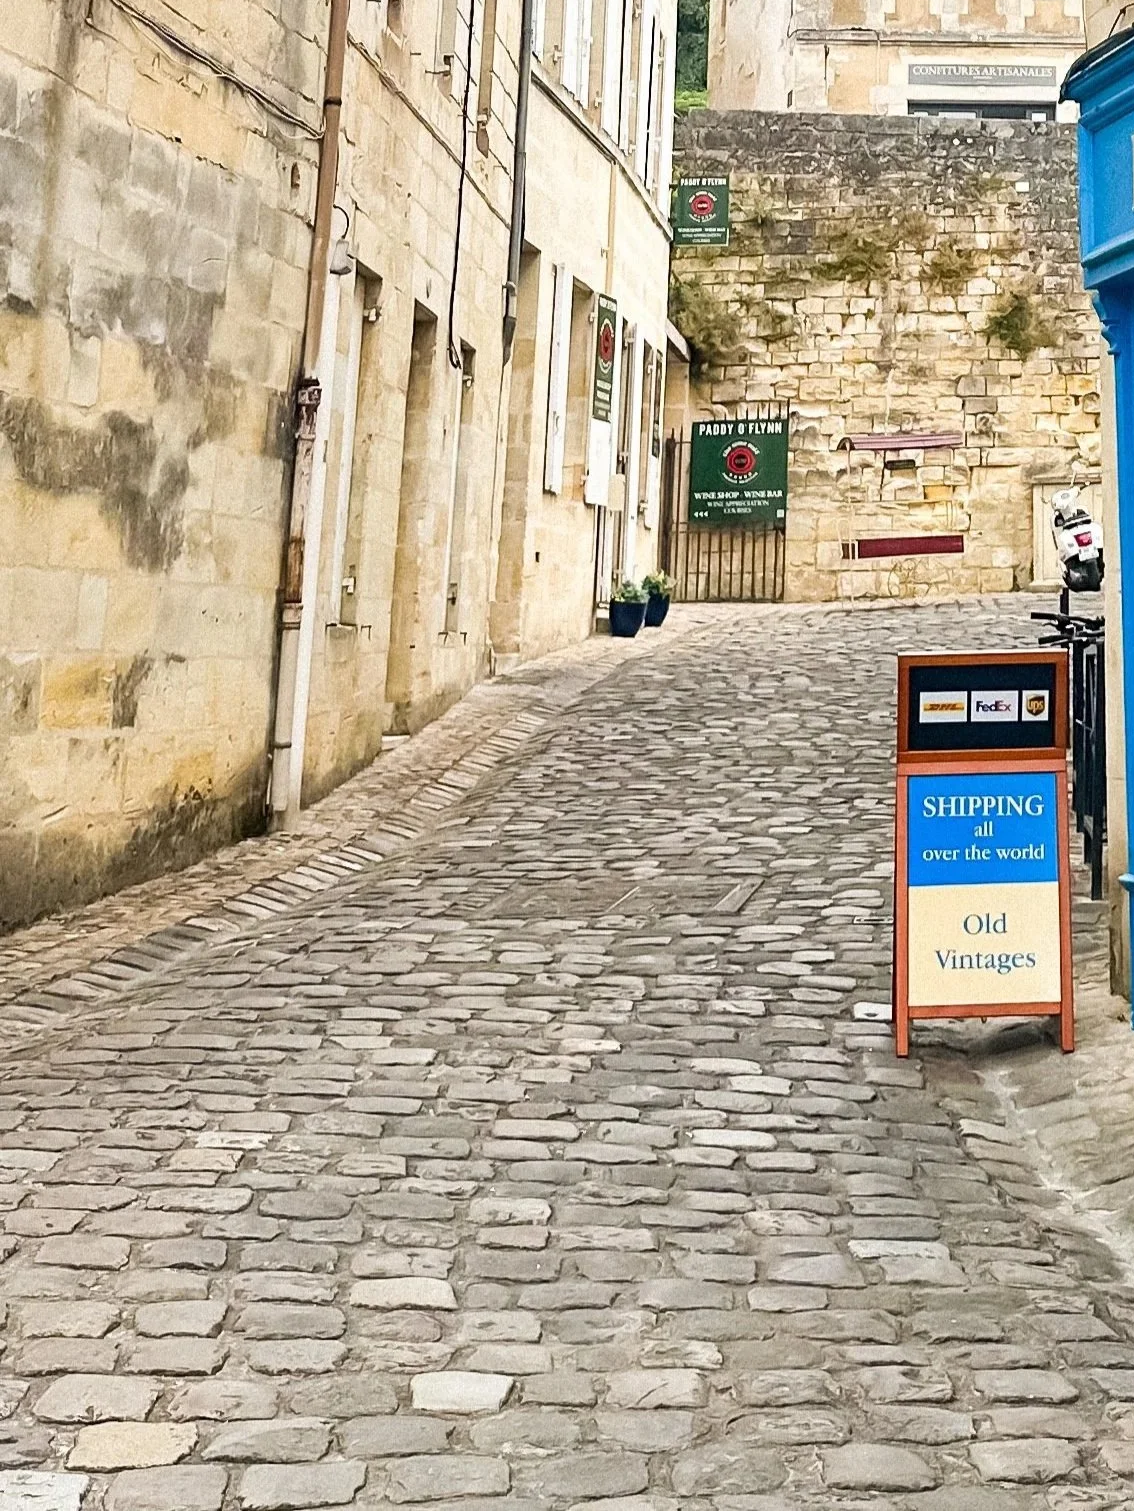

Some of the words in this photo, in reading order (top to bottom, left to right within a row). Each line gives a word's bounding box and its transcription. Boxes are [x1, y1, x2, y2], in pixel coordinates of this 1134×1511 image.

[981, 66, 1053, 77] ARTISANALES
[681, 177, 701, 187] PADDY
[699, 423, 734, 436] PADDY
[738, 422, 783, 435] O'FLYNN
[694, 491, 716, 500] WINE
[717, 491, 740, 499] SHOP
[744, 490, 766, 499] WINE
[767, 489, 783, 498] BAR
[975, 700, 1012, 712] FedEx
[1027, 699, 1044, 714] ups
[922, 795, 1045, 818] SHIPPING
[974, 821, 993, 837] all
[922, 849, 960, 861] over
[965, 843, 991, 861] the
[997, 844, 1045, 860] world
[963, 913, 1008, 935] Old
[935, 949, 1036, 975] Vintages
